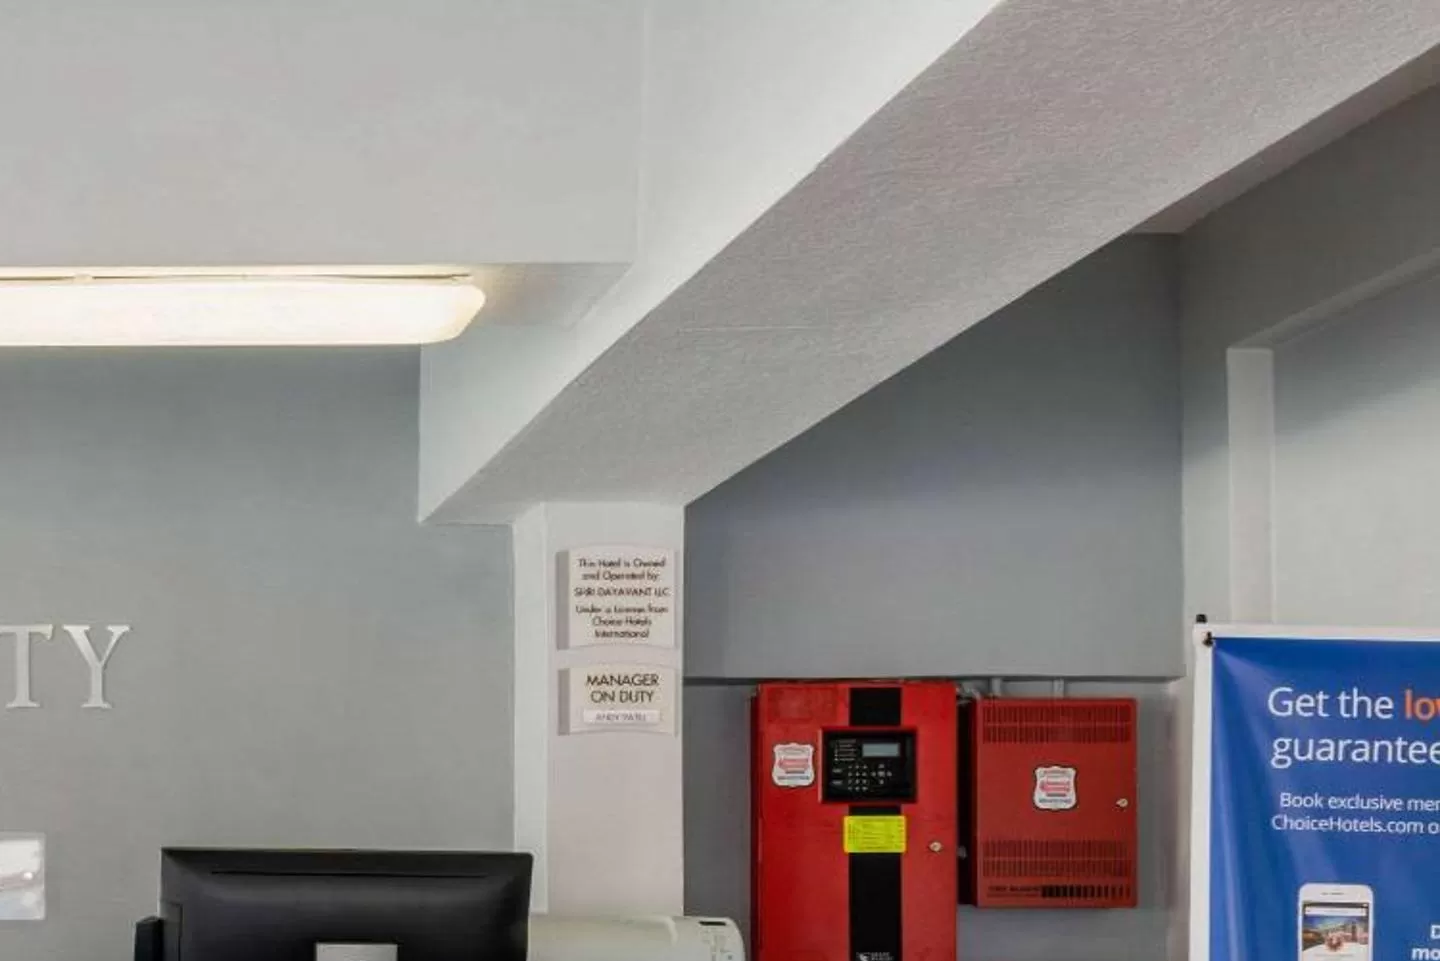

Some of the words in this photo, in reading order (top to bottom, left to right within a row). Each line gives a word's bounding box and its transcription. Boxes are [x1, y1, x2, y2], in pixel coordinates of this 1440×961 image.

[598, 557, 621, 567] Hotel
[633, 556, 666, 567] Owned
[602, 570, 645, 582] Operated
[647, 570, 659, 582] by
[592, 615, 623, 626] Choice
[625, 615, 652, 626] Hotels
[594, 628, 650, 638] International
[585, 673, 660, 687] MANAGER
[590, 690, 616, 703] ON
[619, 690, 655, 703] DUTY
[1268, 686, 1330, 717] Get
[1337, 686, 1394, 719] the
[1279, 792, 1323, 809] Book
[1328, 793, 1403, 812] exclusive
[1271, 814, 1424, 834] ChoiceHotels.com
